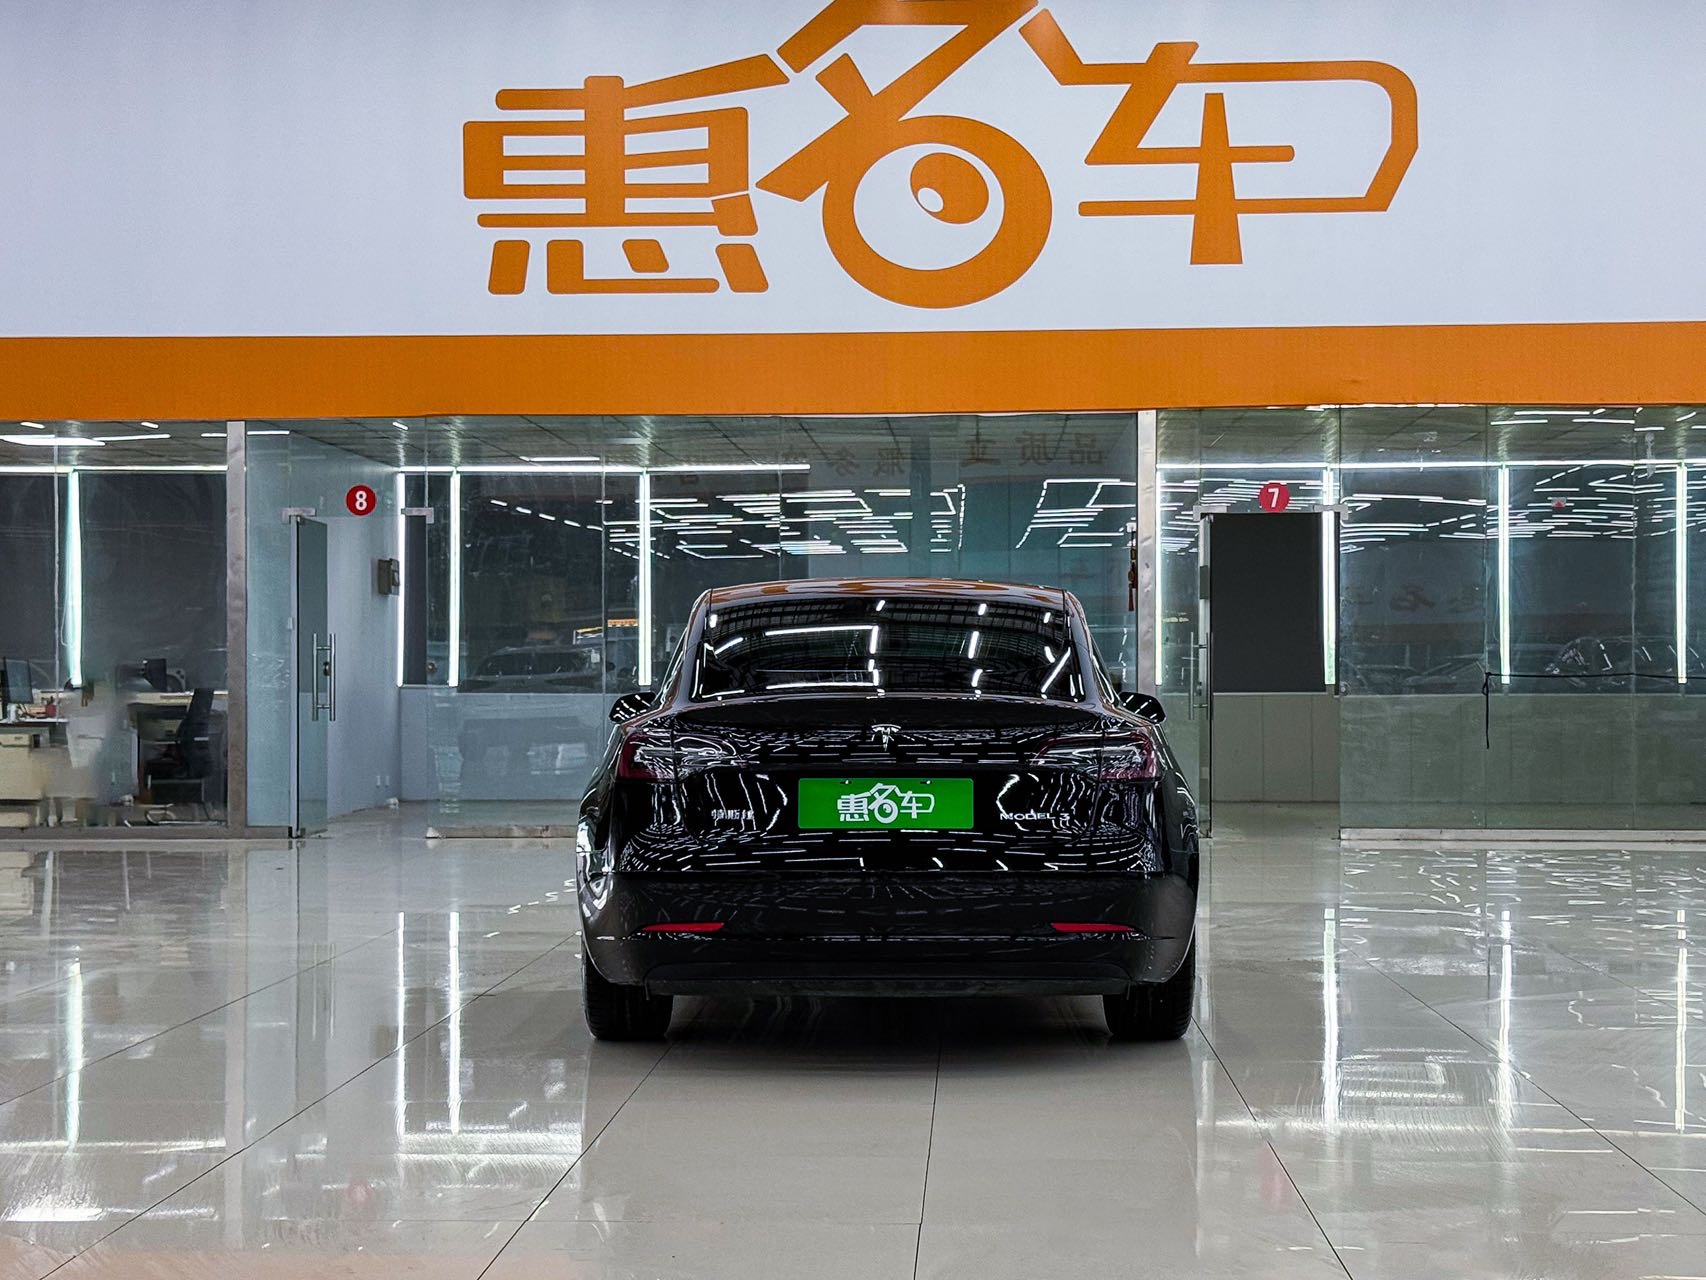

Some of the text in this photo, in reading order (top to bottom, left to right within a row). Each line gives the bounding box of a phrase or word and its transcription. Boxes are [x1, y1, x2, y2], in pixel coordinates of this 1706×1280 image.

[355, 490, 367, 511] 8
[1268, 487, 1279, 508] 7
[1000, 812, 1071, 821] MODEL 3
